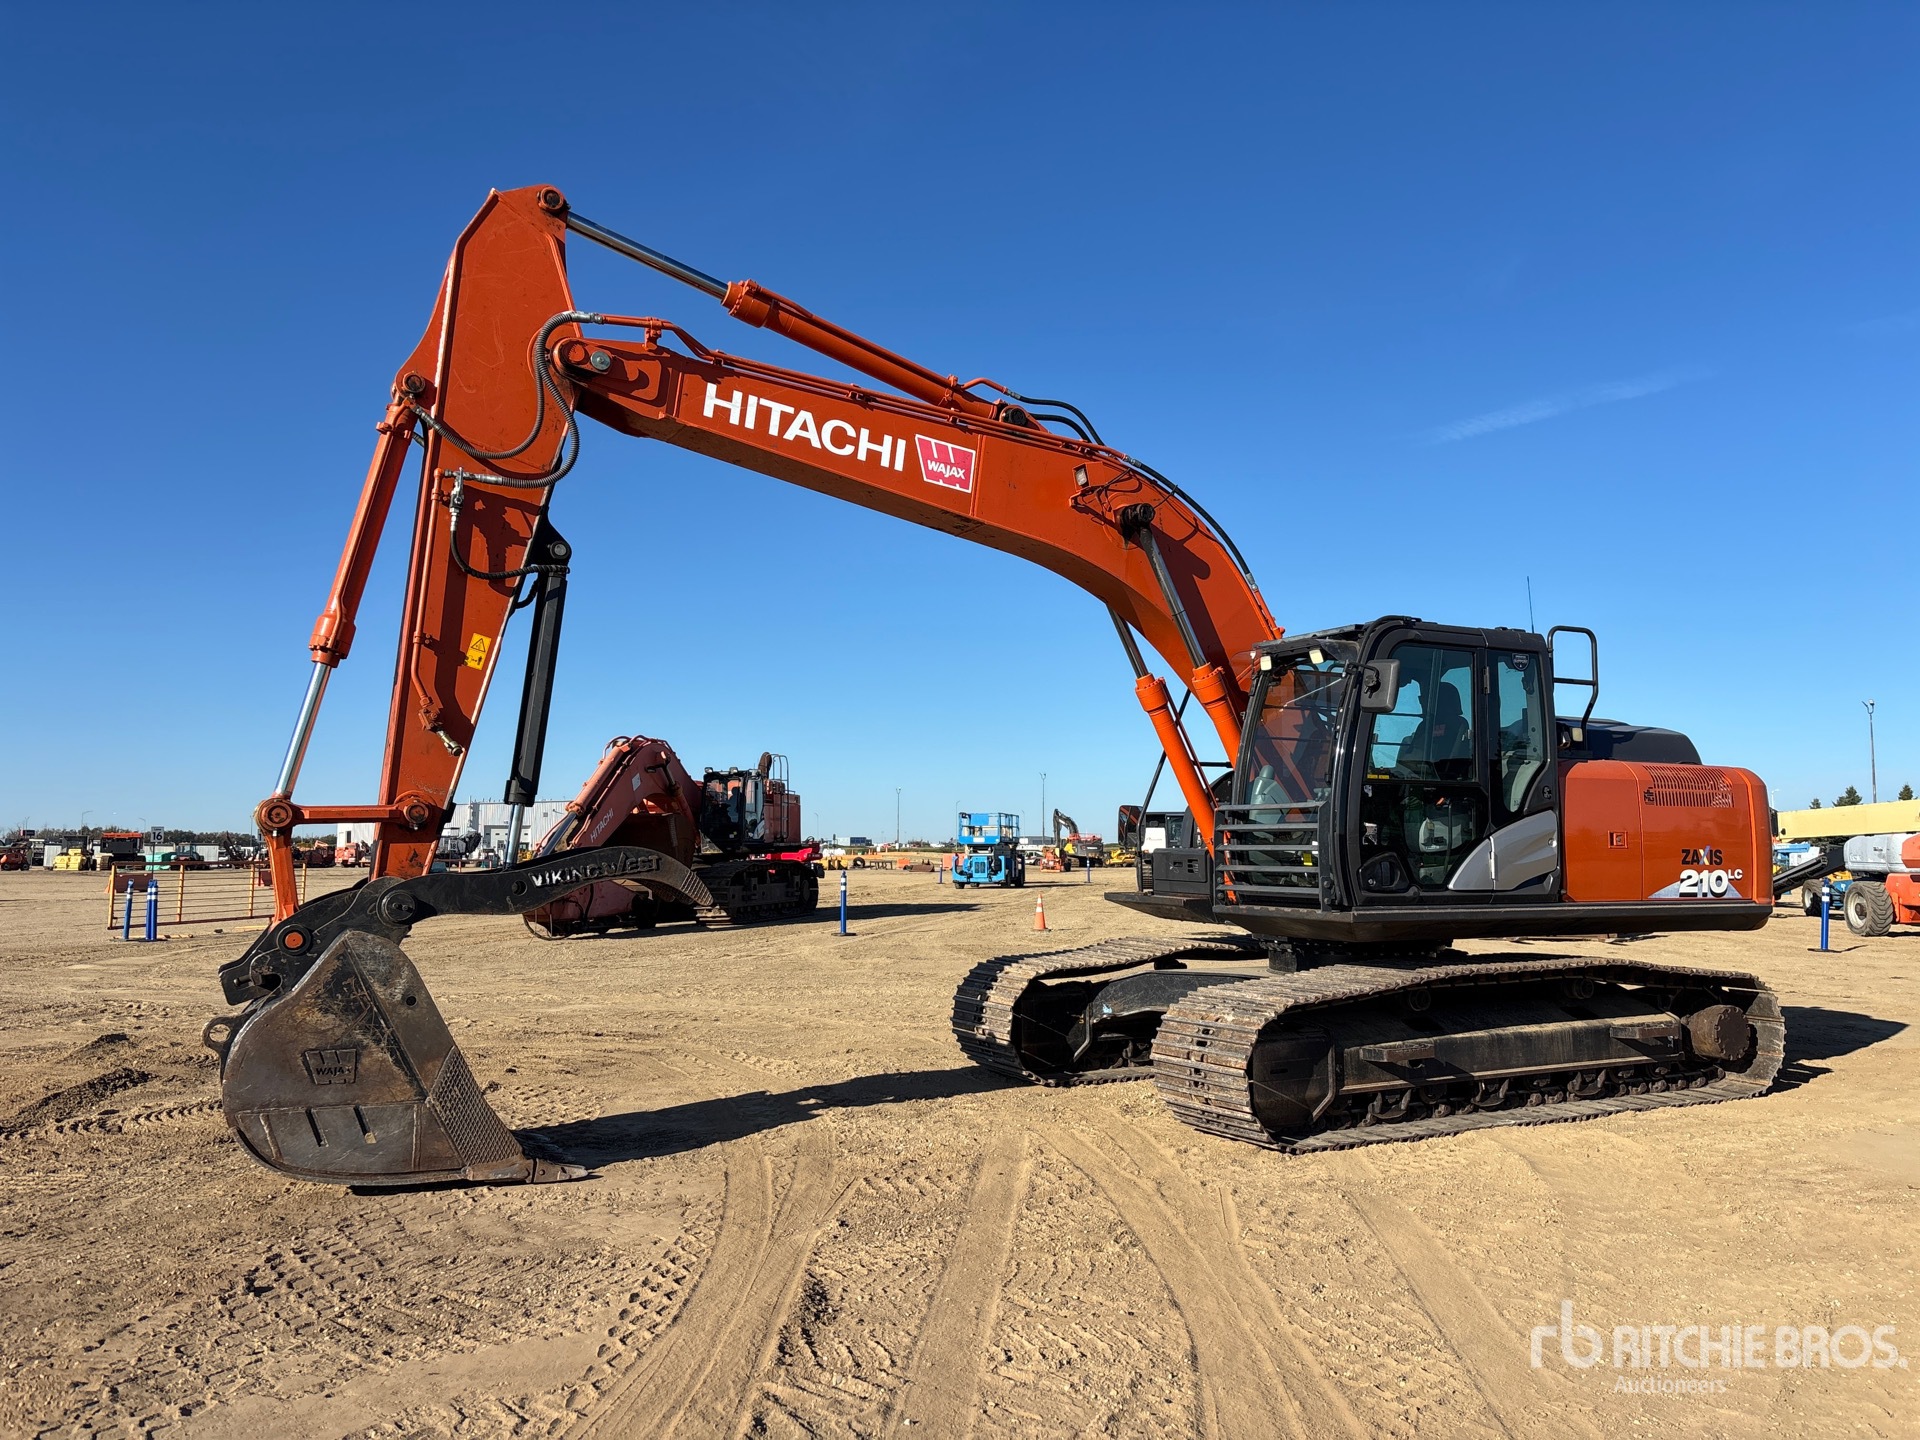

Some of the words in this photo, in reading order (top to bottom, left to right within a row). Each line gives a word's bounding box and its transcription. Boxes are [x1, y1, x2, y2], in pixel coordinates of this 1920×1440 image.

[702, 382, 907, 472] HITACHI
[927, 459, 966, 480] WAJAX
[152, 831, 163, 841] 16
[590, 807, 614, 844] HITACHI
[1681, 845, 1723, 866] ZAXIS
[315, 1065, 352, 1077] WAJAX
